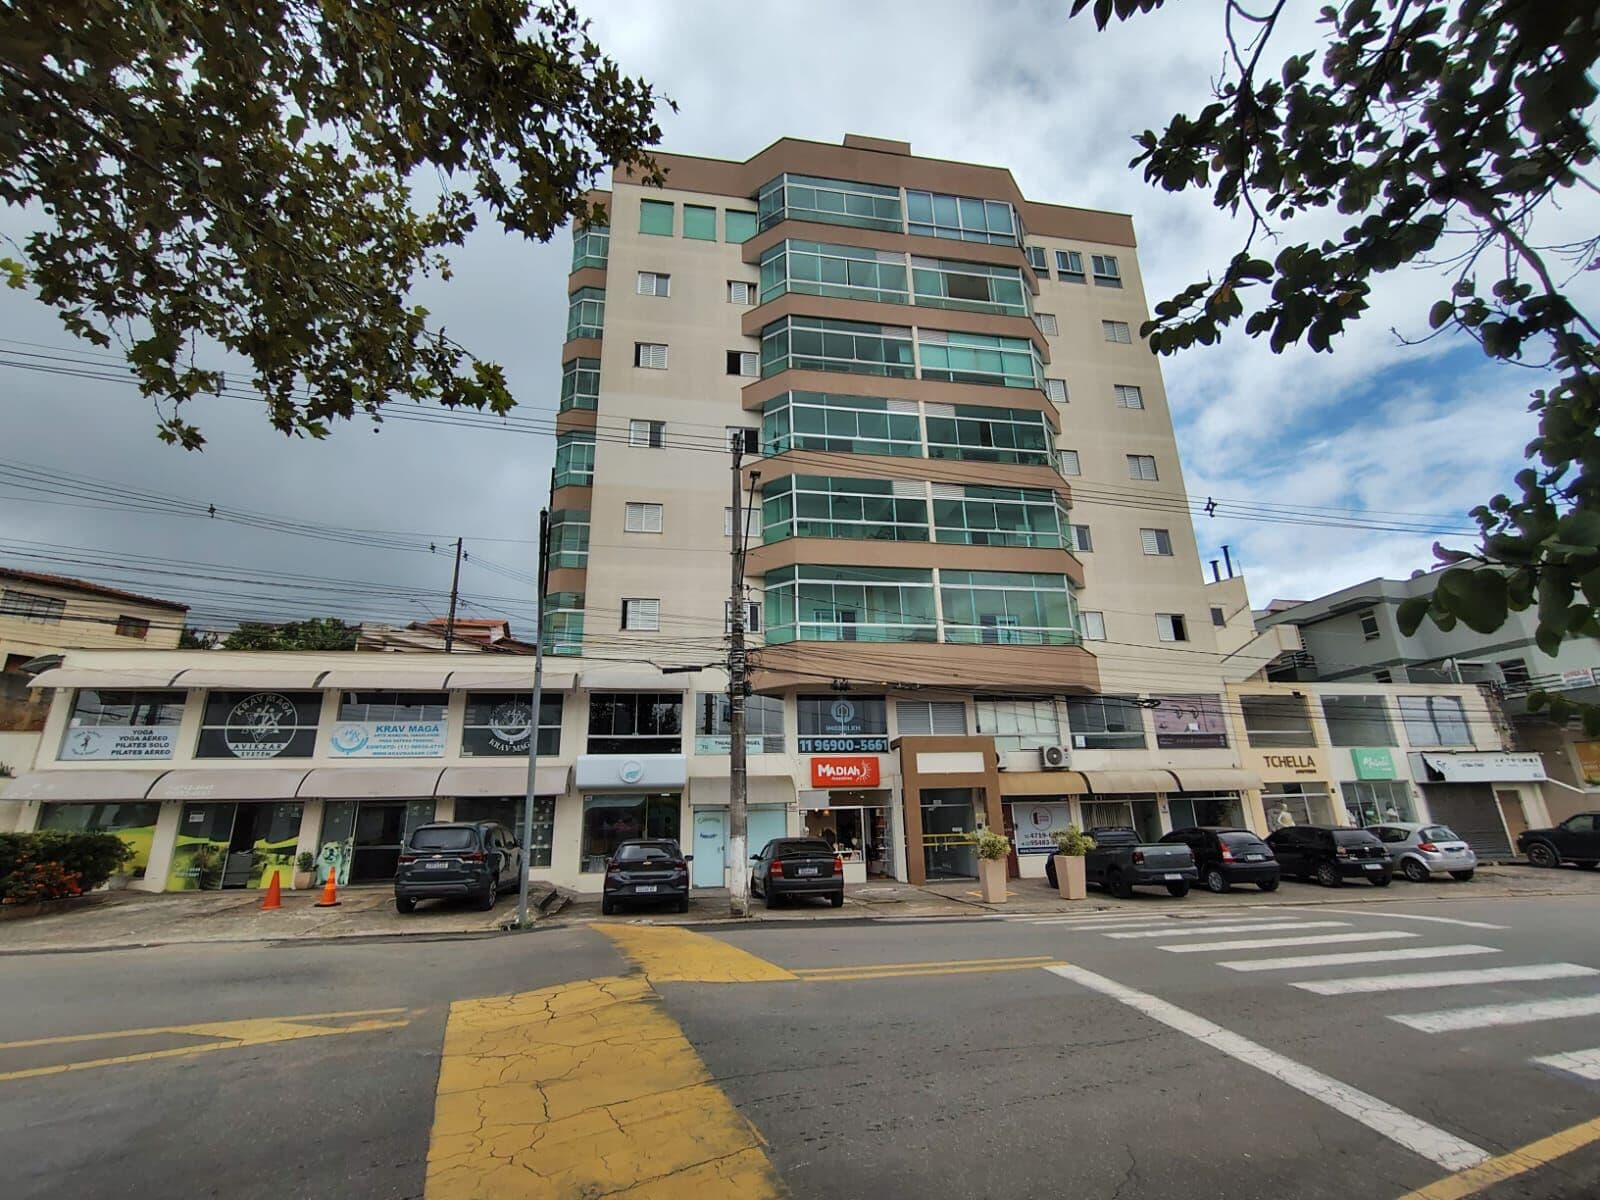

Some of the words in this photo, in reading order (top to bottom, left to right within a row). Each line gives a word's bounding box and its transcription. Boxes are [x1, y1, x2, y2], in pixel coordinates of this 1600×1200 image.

[235, 695, 264, 716] KRAV
[376, 725, 406, 733] KRAV
[799, 739, 812, 751] 11
[814, 739, 888, 751] 96900-5661
[1263, 755, 1316, 768] TCHELLA
